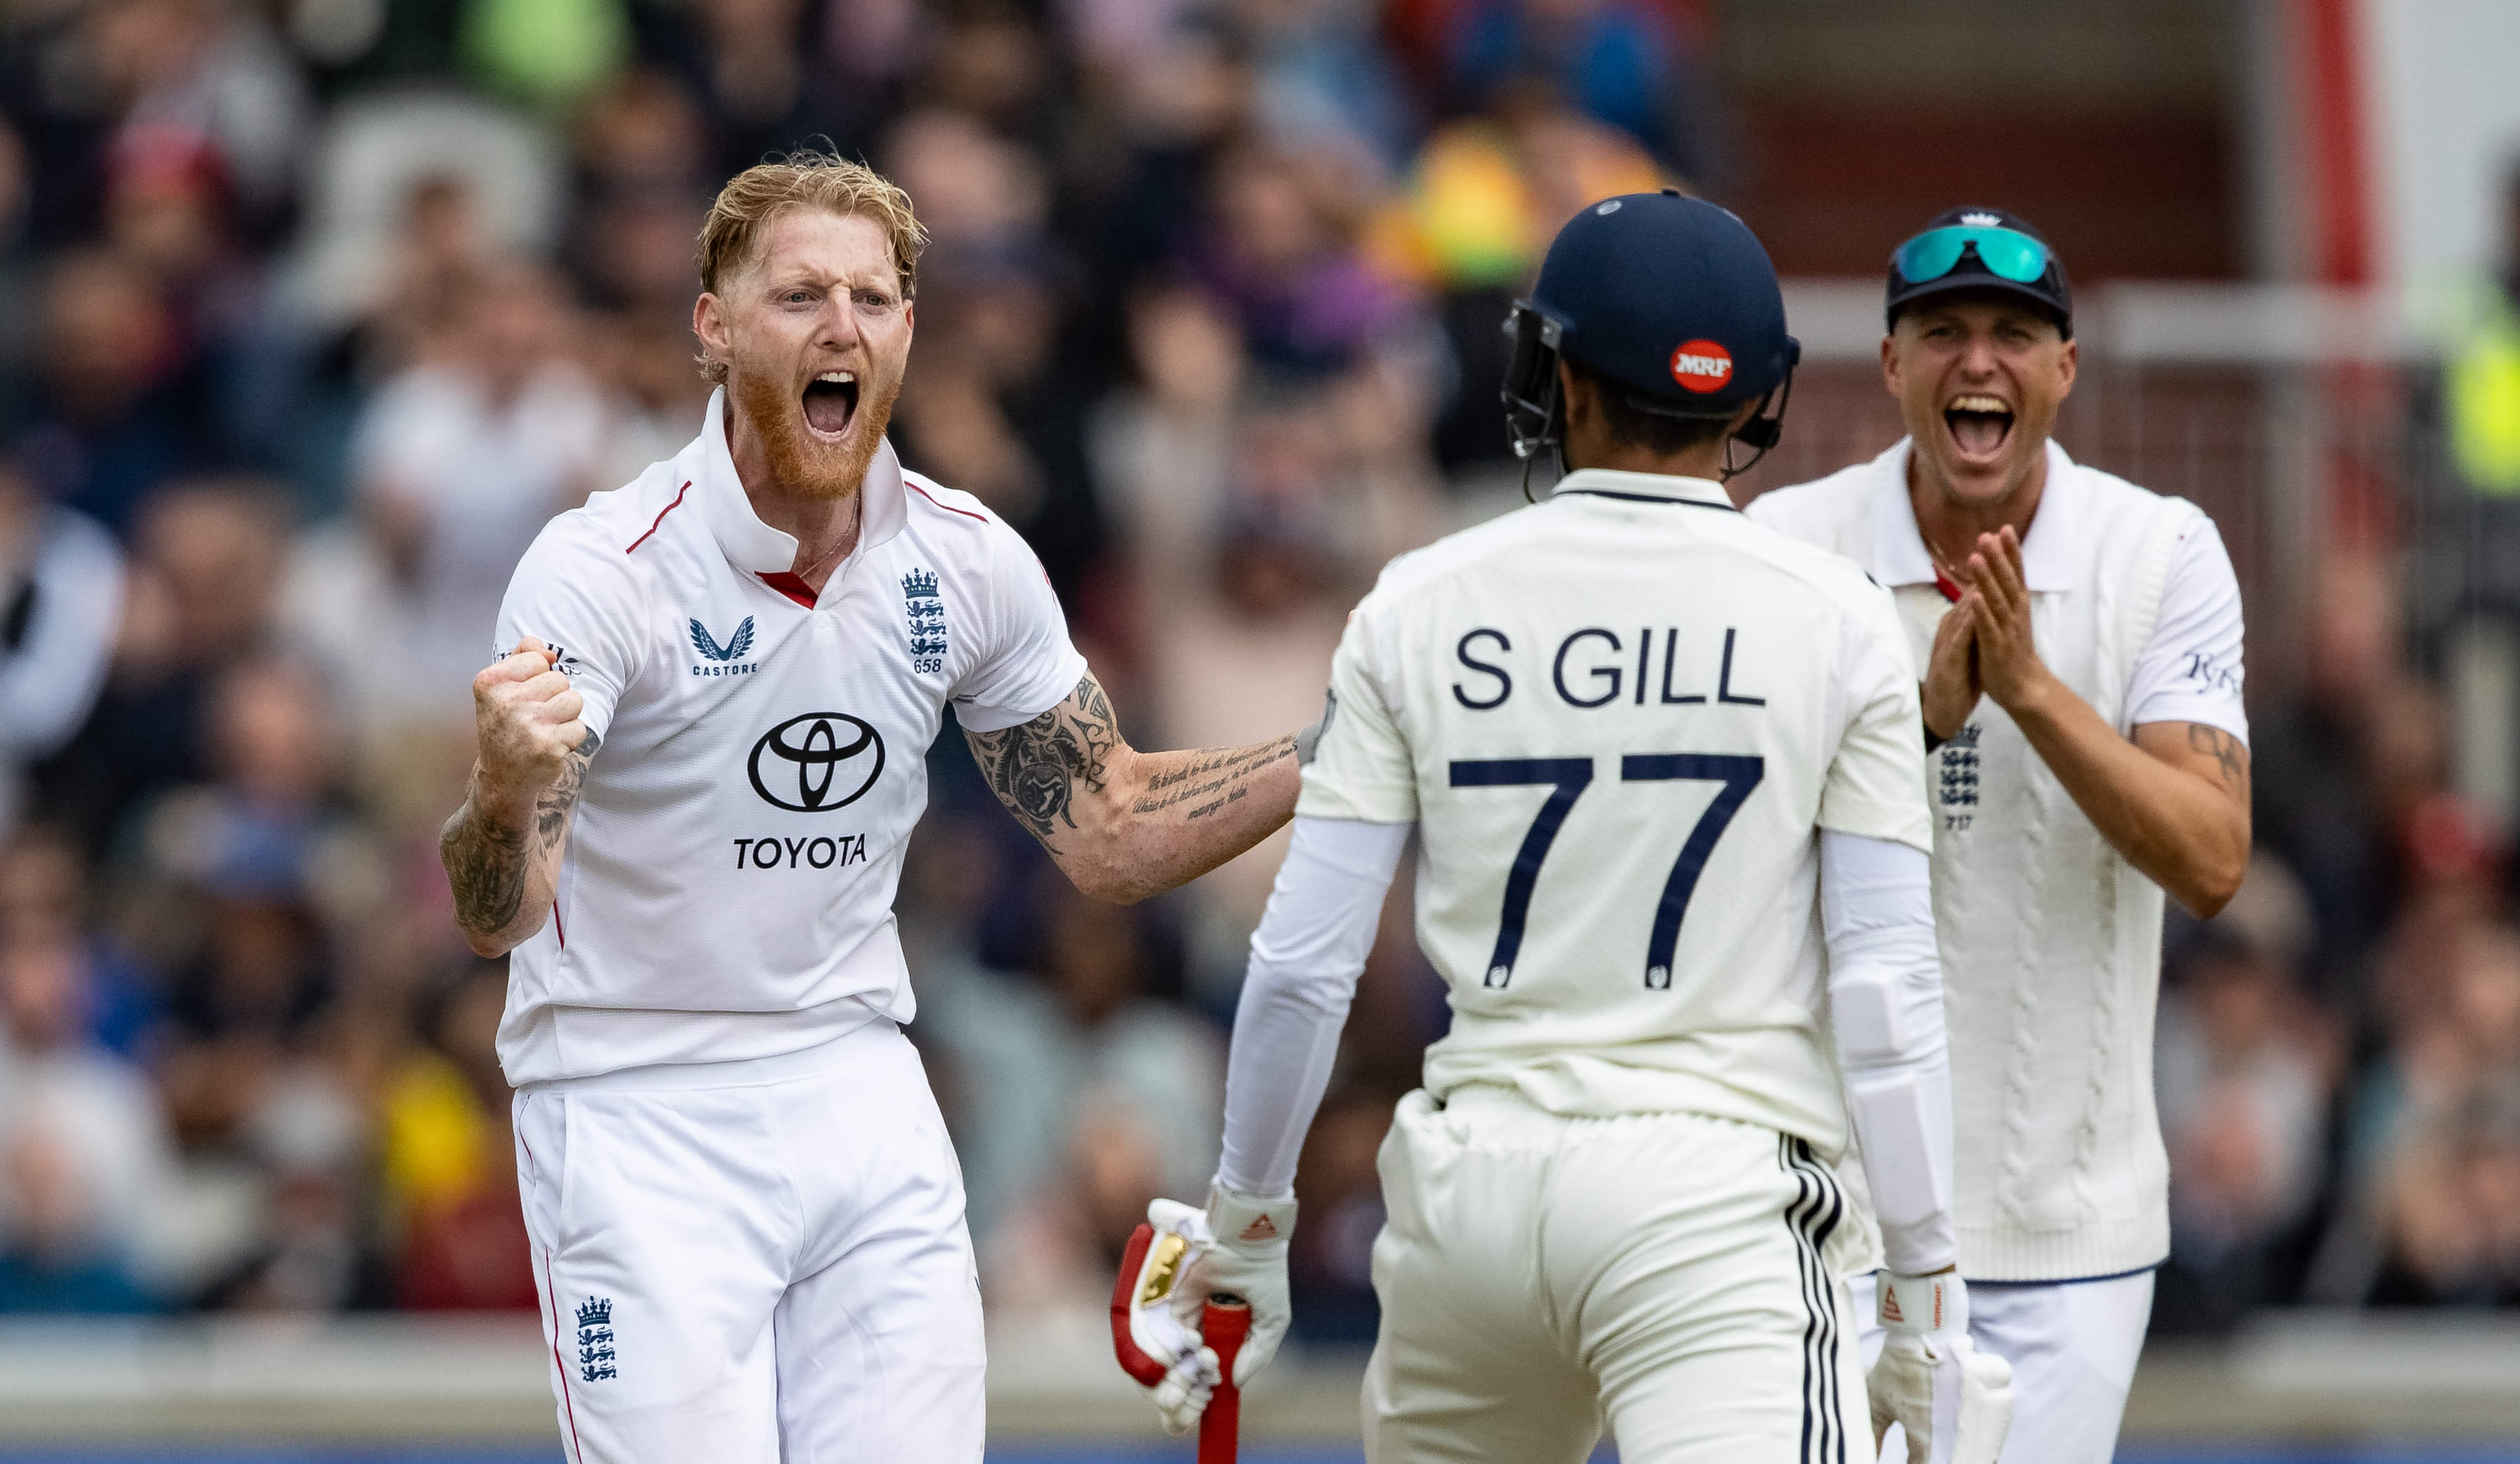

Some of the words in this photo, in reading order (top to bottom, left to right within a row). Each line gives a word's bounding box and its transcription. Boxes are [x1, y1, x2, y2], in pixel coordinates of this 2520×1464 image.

[1676, 353, 1731, 377] MRF
[693, 663, 758, 676] CASTORE
[914, 658, 942, 674] 658
[1453, 628, 1512, 710] S
[1553, 628, 1766, 708] GILL
[734, 832, 867, 870] TOYOTA
[1449, 753, 1764, 989] 77
